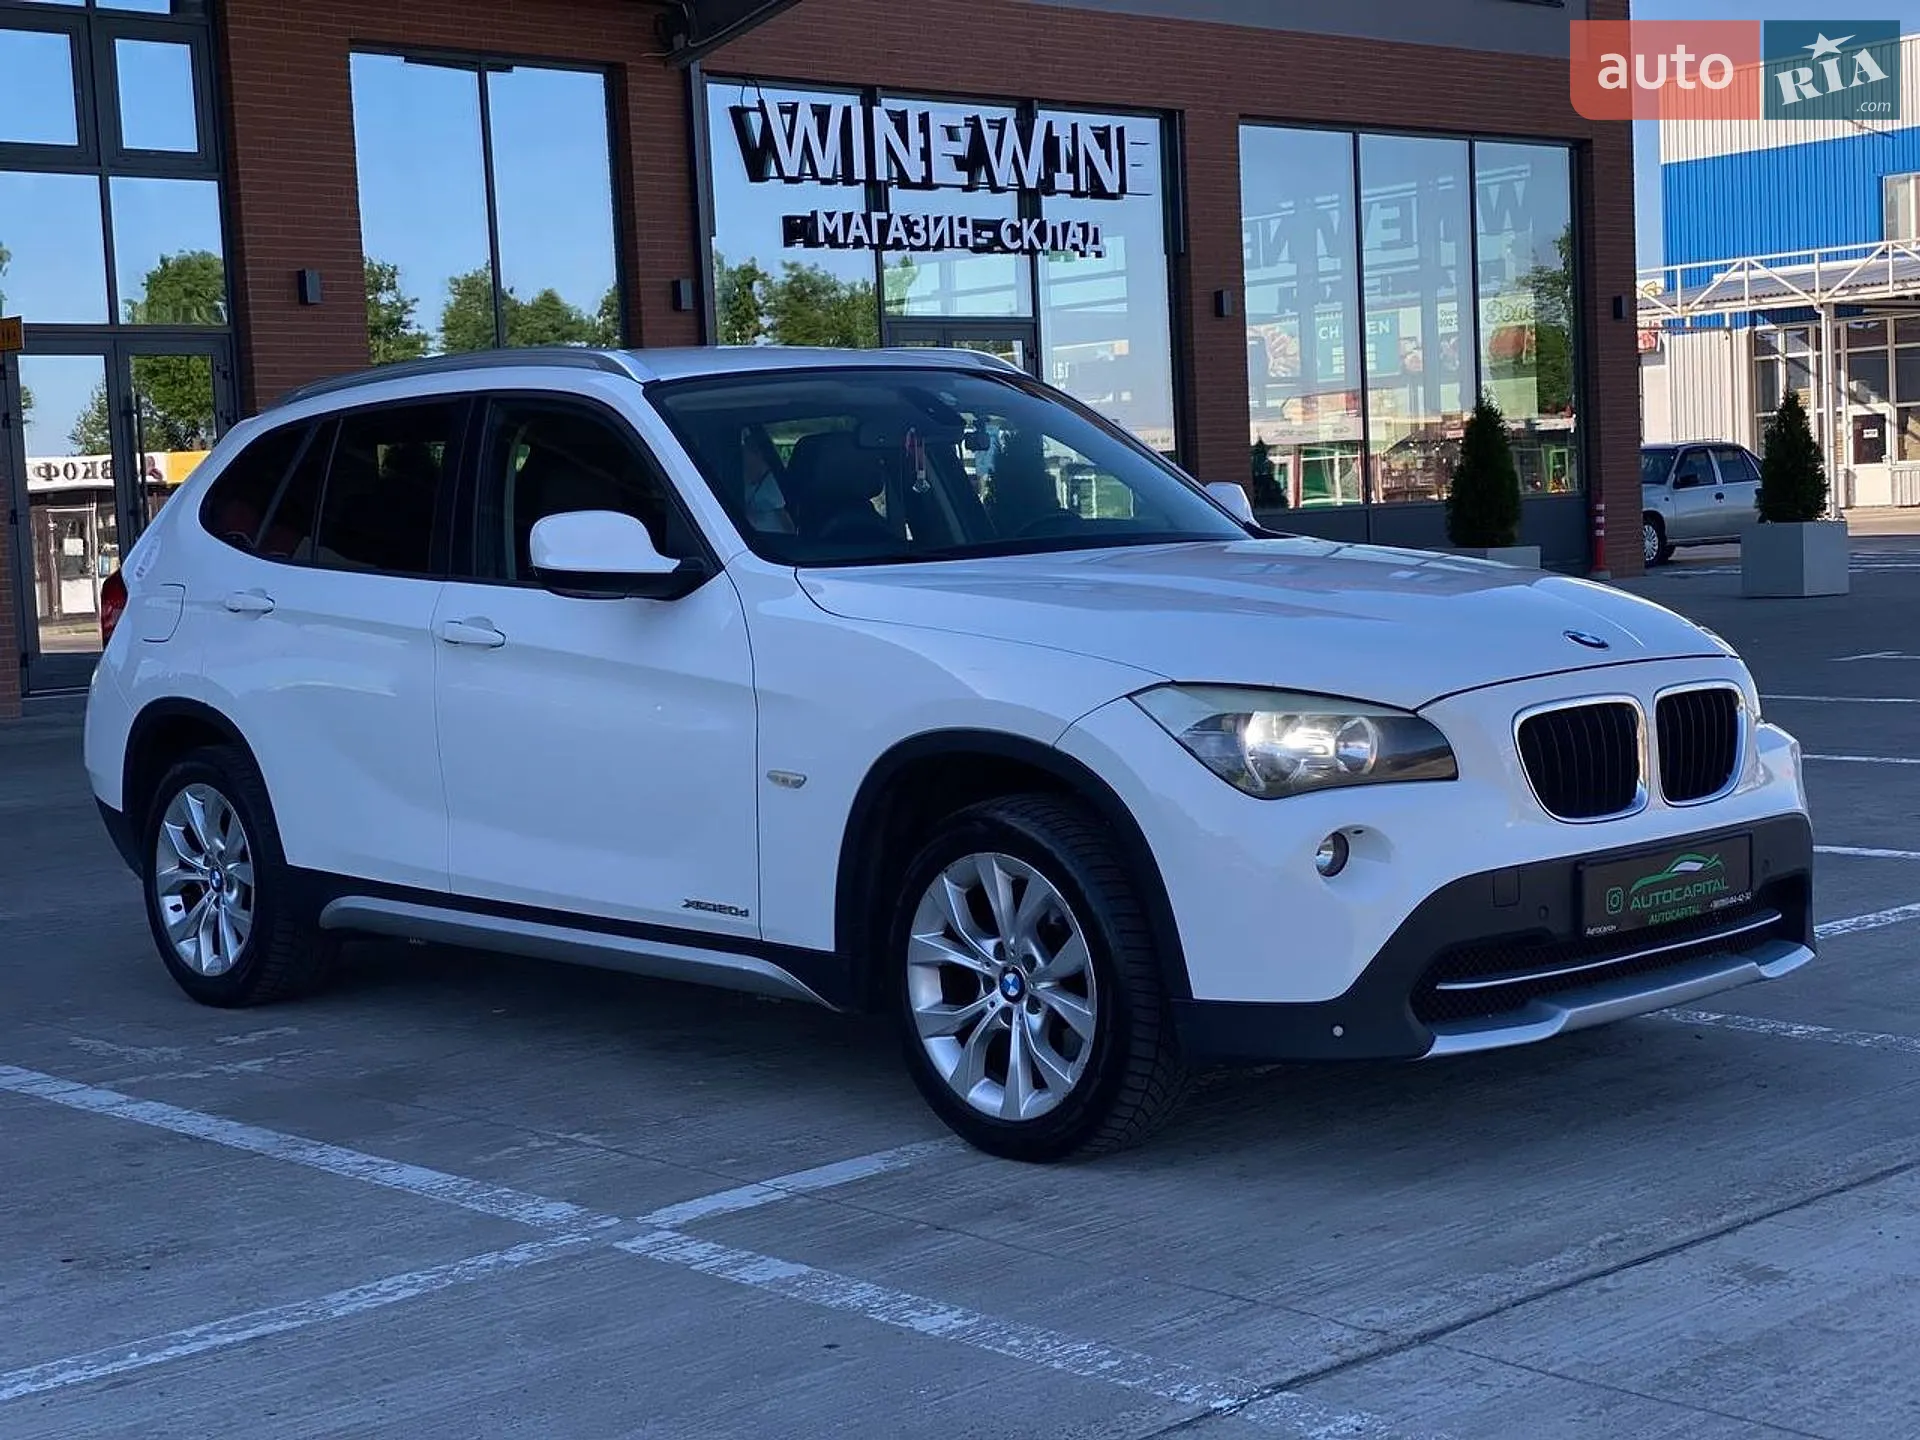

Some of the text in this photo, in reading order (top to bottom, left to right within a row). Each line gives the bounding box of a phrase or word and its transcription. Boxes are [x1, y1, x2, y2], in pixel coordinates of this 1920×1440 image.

[748, 97, 1153, 197] WINEWINE
[1631, 878, 1729, 911] AUTOCAPITAL
[1648, 905, 1701, 925] AUTOCAPITAL
